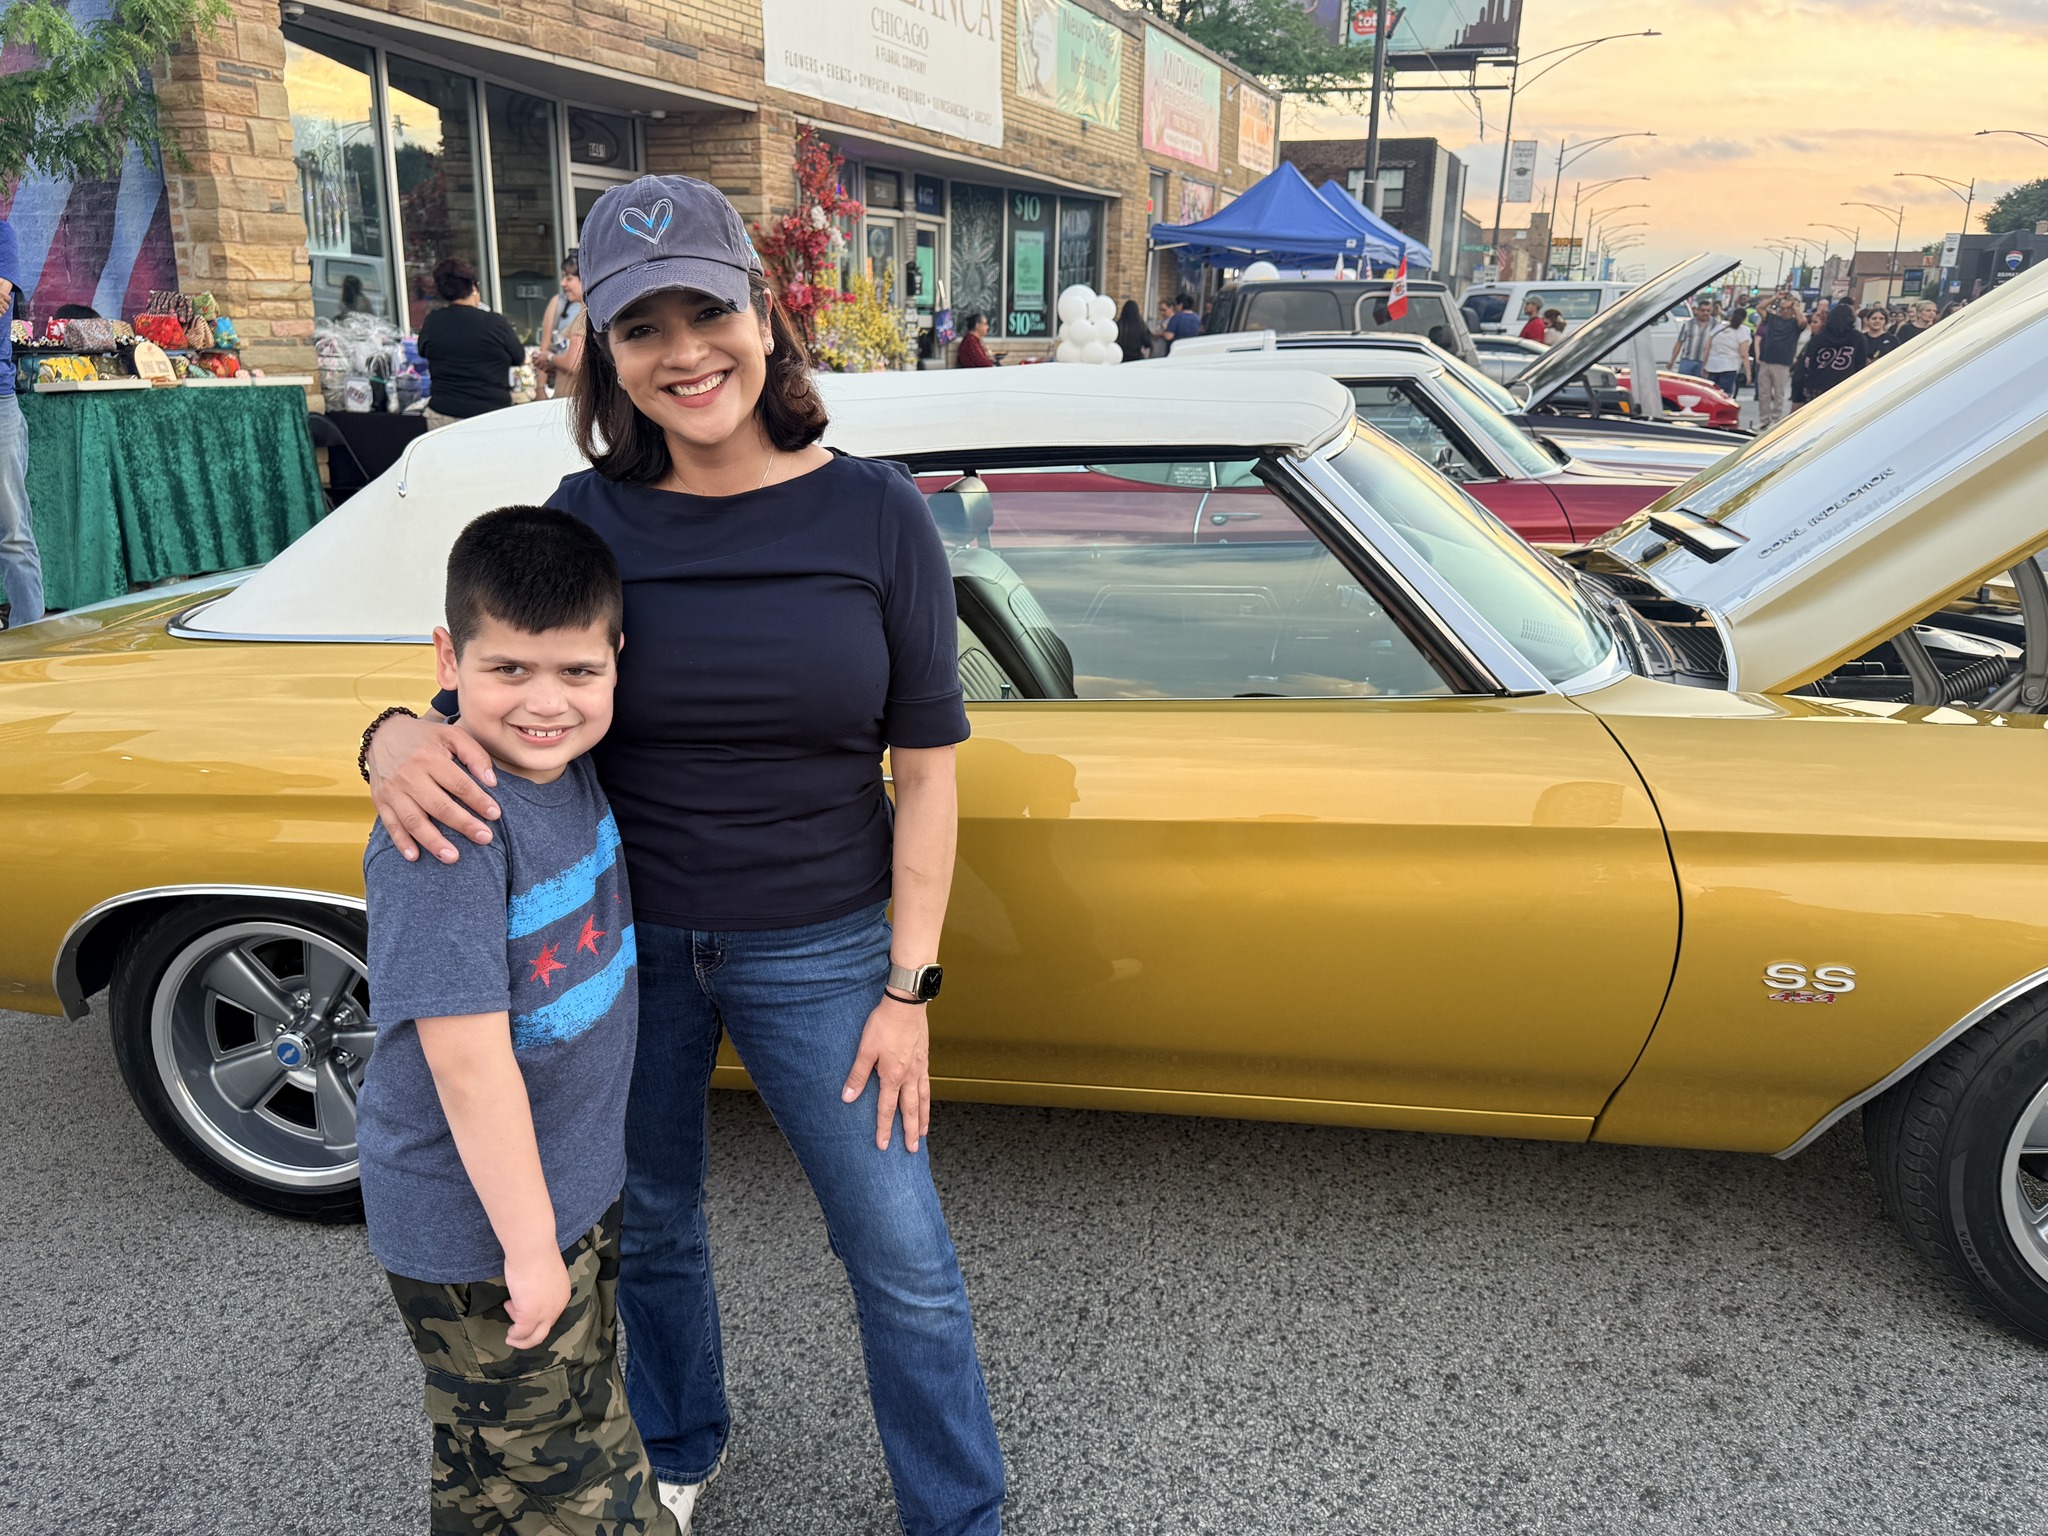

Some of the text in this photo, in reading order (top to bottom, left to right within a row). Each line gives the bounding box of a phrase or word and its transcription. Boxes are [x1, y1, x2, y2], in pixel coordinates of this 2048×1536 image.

[871, 6, 929, 49] CHICAGO
[1358, 11, 1391, 27] totl
[785, 50, 818, 74] FLOWERS
[827, 62, 852, 84] EVENTS
[1014, 194, 1041, 221] $10
[1008, 311, 1031, 335] $10
[1816, 346, 1855, 370] 95
[1758, 466, 1896, 559] COWL INDUCTION
[1763, 961, 1857, 993] SS
[1767, 990, 1838, 1005] 454
